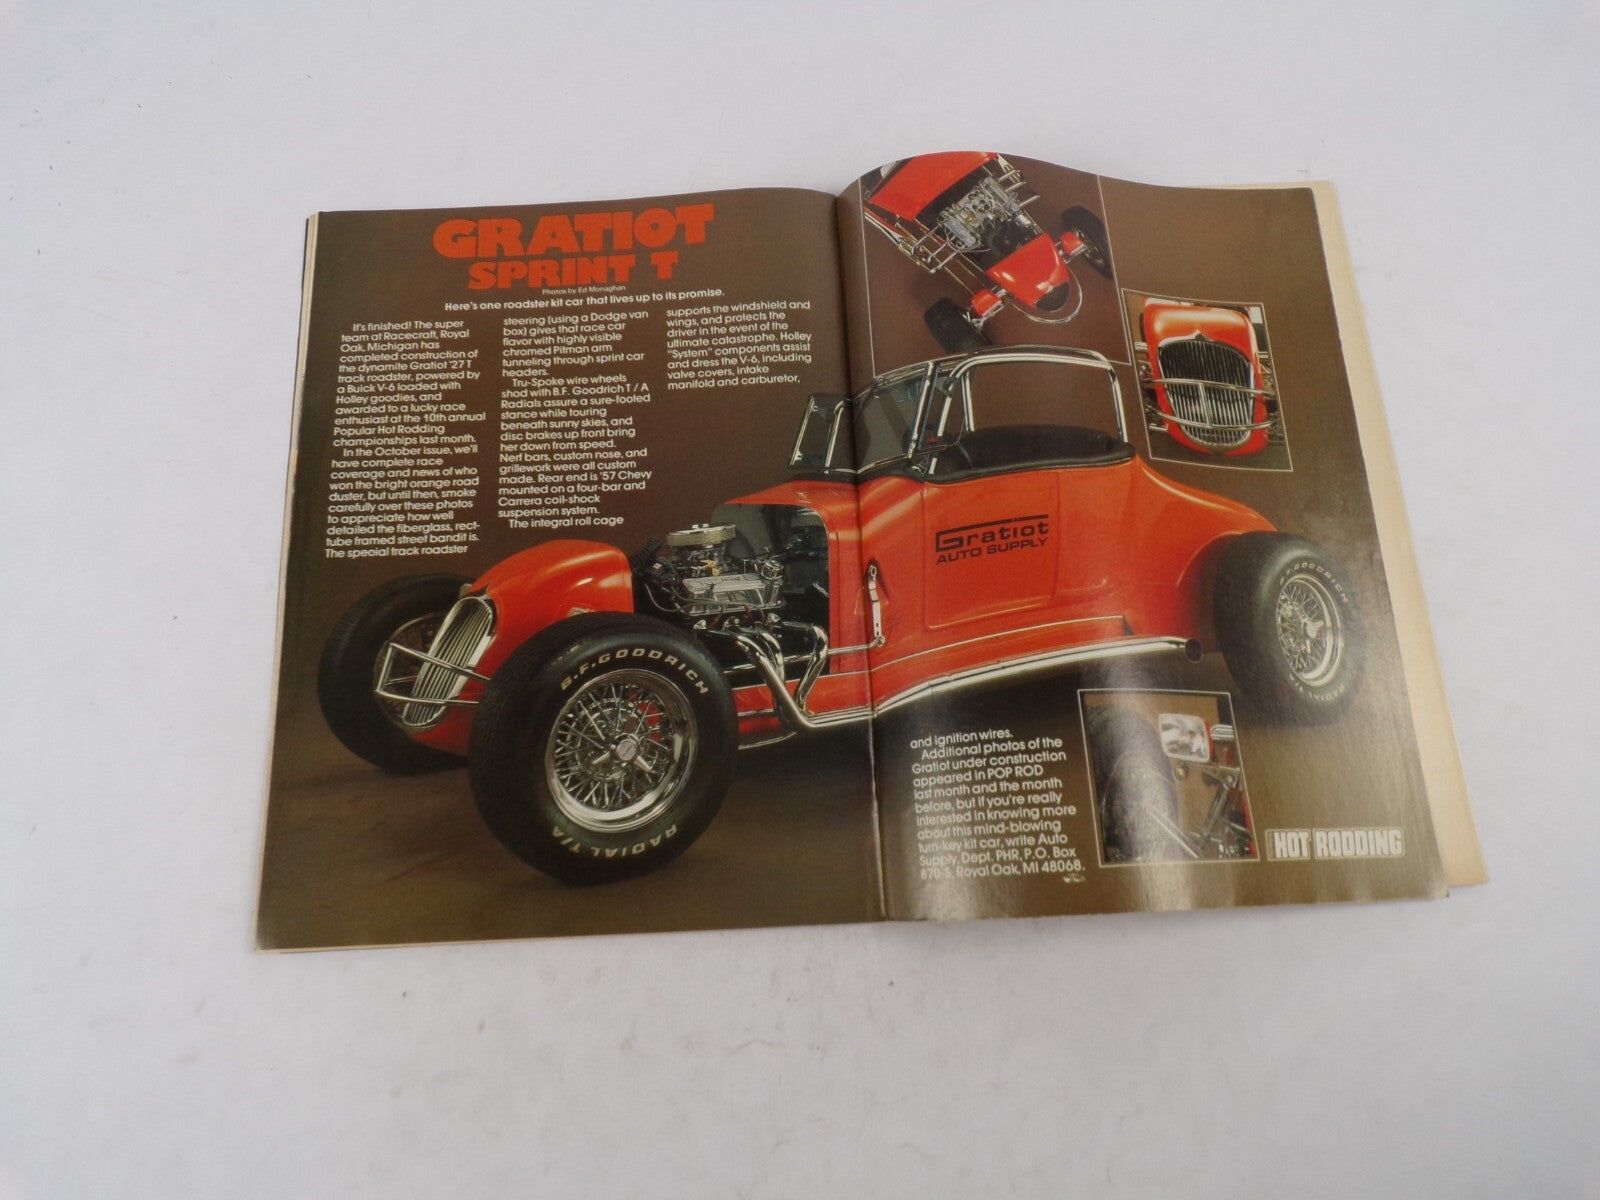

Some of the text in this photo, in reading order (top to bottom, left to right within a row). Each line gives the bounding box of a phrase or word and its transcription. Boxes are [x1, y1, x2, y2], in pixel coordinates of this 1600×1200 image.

[433, 203, 714, 259] GRATIOT
[468, 250, 679, 290] SPRINT T
[542, 288, 567, 296] Photos
[578, 286, 588, 294] Ed
[588, 284, 626, 293] Monaghan
[480, 302, 502, 310] one
[504, 298, 550, 309] roadster
[551, 297, 564, 306] kit
[565, 298, 584, 306] car
[586, 295, 608, 305] that
[610, 294, 634, 303] lives
[636, 294, 650, 304] up
[652, 292, 664, 301] to
[666, 291, 677, 300] its
[667, 299, 811, 317] supports the windshield and
[504, 316, 546, 326] steering
[548, 315, 579, 325] (using
[590, 312, 628, 322] Dodge
[701, 315, 723, 324] and
[725, 312, 768, 324] protects
[769, 311, 786, 319] the
[368, 321, 412, 330] finished!
[414, 321, 433, 329] The
[434, 321, 464, 330] super
[503, 327, 527, 337] box)
[529, 326, 557, 336] gives
[558, 324, 579, 333] that
[580, 324, 606, 332] race
[667, 321, 789, 337] driver in the event of the
[342, 334, 370, 342] team
[371, 333, 382, 341] at
[440, 329, 470, 339] Royal
[503, 333, 622, 346] flavor with highly visible
[667, 337, 710, 347] ultimate
[780, 331, 812, 341] Holley
[367, 342, 419, 352] Michigan
[421, 341, 440, 349] has
[503, 346, 552, 356] chromed
[554, 345, 590, 354] Pitman
[715, 344, 781, 355] components
[783, 342, 810, 351] assist
[340, 349, 478, 363] completed construction of
[502, 353, 644, 367] tunneling through sprint car
[668, 360, 690, 368] and
[692, 359, 720, 367] dress
[721, 357, 738, 365] the
[762, 353, 812, 363] including
[339, 364, 356, 372] the
[358, 362, 408, 373] dynamite
[410, 361, 448, 370] Gratiot
[668, 370, 696, 379] valve
[737, 365, 769, 375] intake
[338, 374, 365, 383] track
[416, 371, 465, 382] powered
[467, 370, 480, 380] by
[566, 376, 589, 385] wire
[590, 374, 627, 383] wheels
[668, 379, 715, 389] manifold
[717, 377, 739, 386] and
[347, 384, 376, 393] Buick
[397, 382, 438, 391] loaded
[439, 381, 461, 389] with
[336, 395, 369, 405] Holley
[419, 392, 442, 401] and
[936, 514, 1048, 552] Gratiot
[936, 537, 1048, 564] AUTO SUPPLY
[910, 735, 932, 748] and
[934, 732, 978, 747] ignition
[922, 737, 1063, 759] Additional photos of the
[912, 751, 1067, 772] Gratiot under construction
[913, 765, 1044, 788] appeared in POP ROD
[914, 776, 1063, 799] last month and the month
[956, 798, 976, 809] but
[978, 797, 985, 807] if
[1027, 791, 1062, 804] really
[917, 805, 1077, 825] interested in knowing more
[918, 827, 951, 839] about
[953, 826, 972, 837] this
[591, 824, 679, 858] RADIAL
[1274, 830, 1402, 858] HOT RODDING
[957, 866, 990, 879] Royal
[1022, 863, 1039, 874] MI
